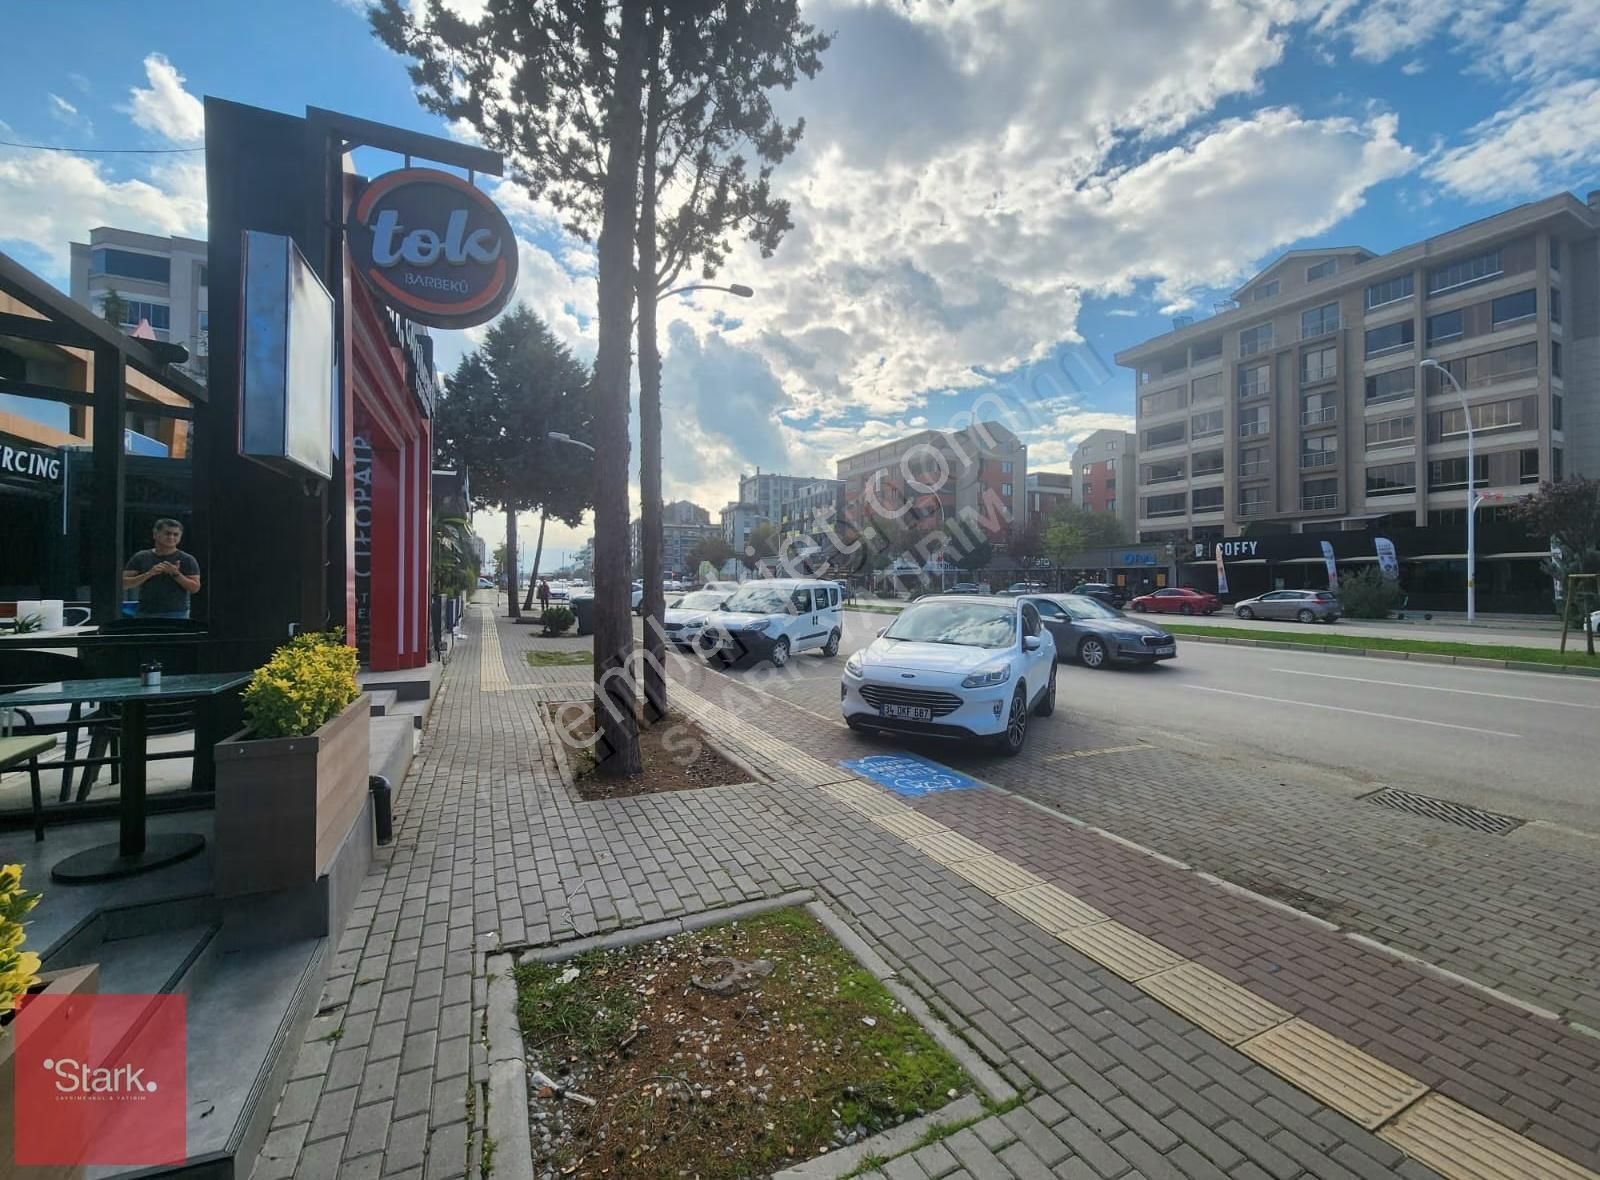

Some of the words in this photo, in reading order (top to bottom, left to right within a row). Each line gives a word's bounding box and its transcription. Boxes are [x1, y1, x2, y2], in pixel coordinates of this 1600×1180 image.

[370, 209, 501, 268] tok
[0, 445, 61, 480] RCING
[1215, 541, 1257, 556] COFFY
